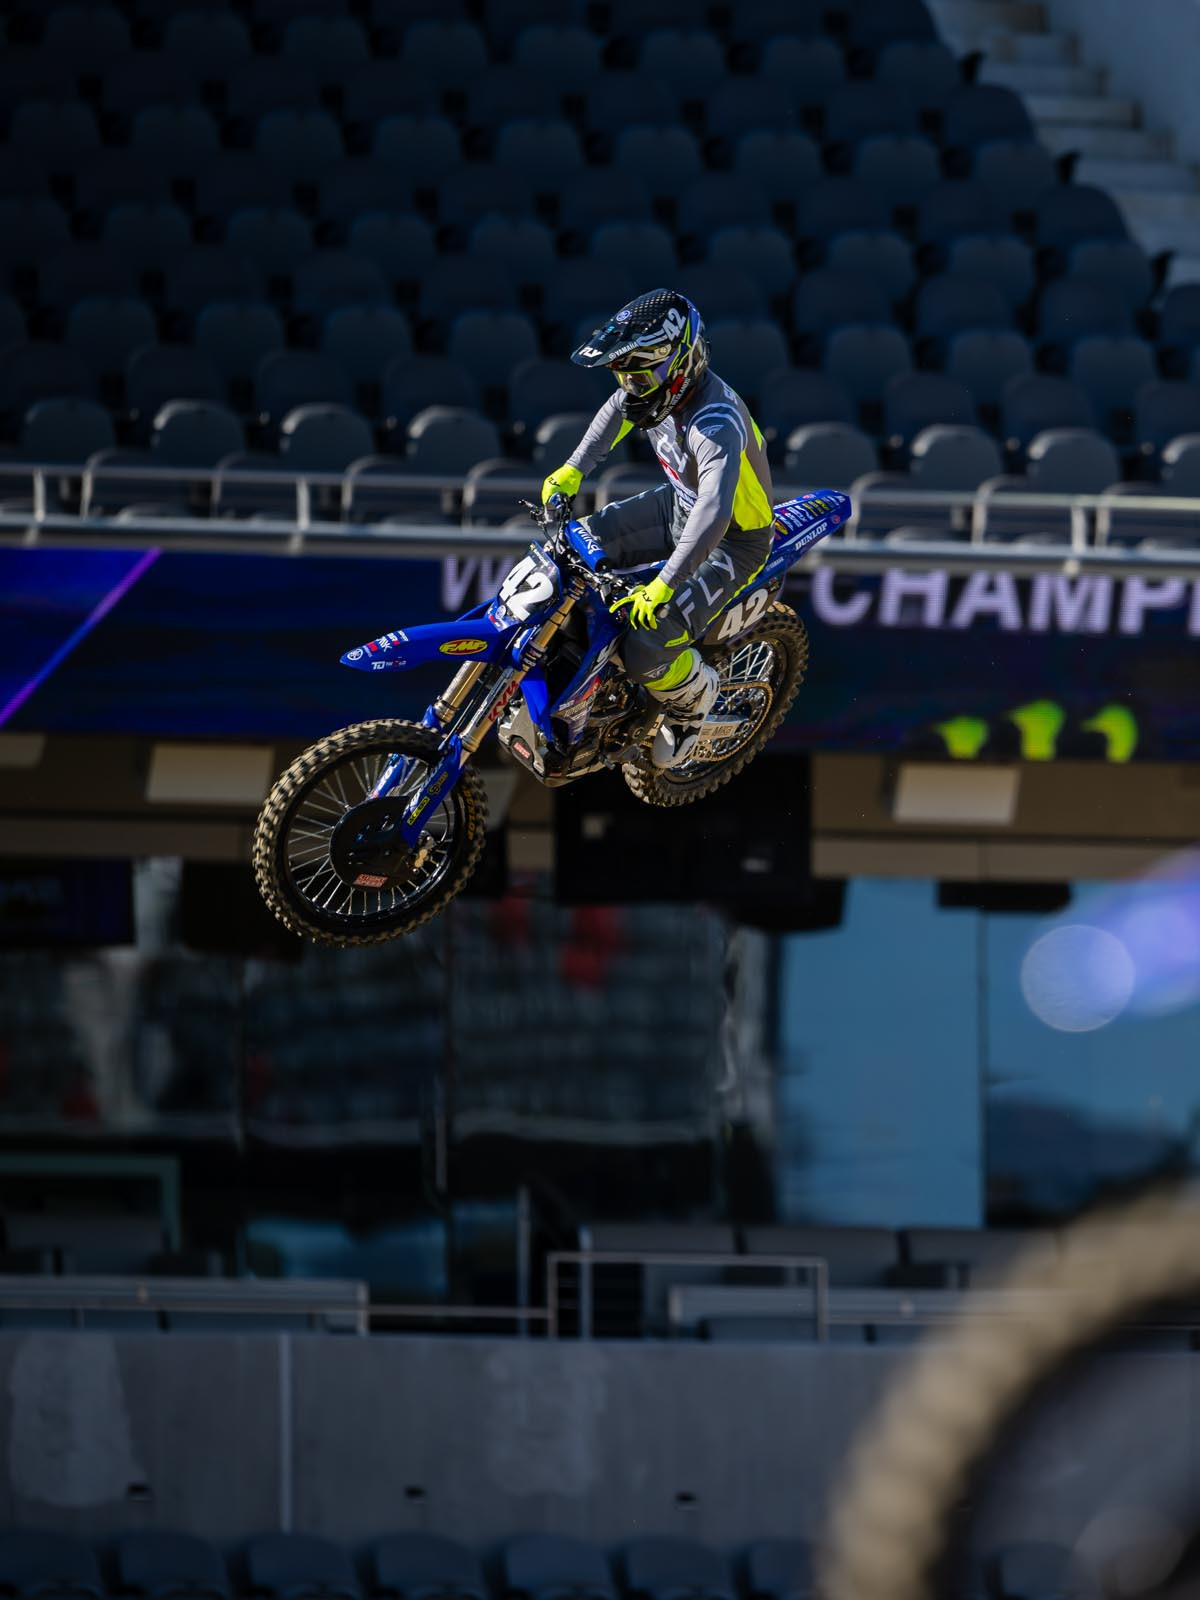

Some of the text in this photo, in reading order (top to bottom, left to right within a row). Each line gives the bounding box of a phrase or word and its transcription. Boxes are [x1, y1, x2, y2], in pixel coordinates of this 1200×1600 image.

[662, 308, 687, 342] 42
[578, 346, 603, 358] FLY
[794, 521, 829, 552] DUNLOP
[500, 555, 554, 622] 42
[675, 552, 736, 629] FLY
[716, 588, 769, 641] 42
[438, 638, 488, 655] FMF
